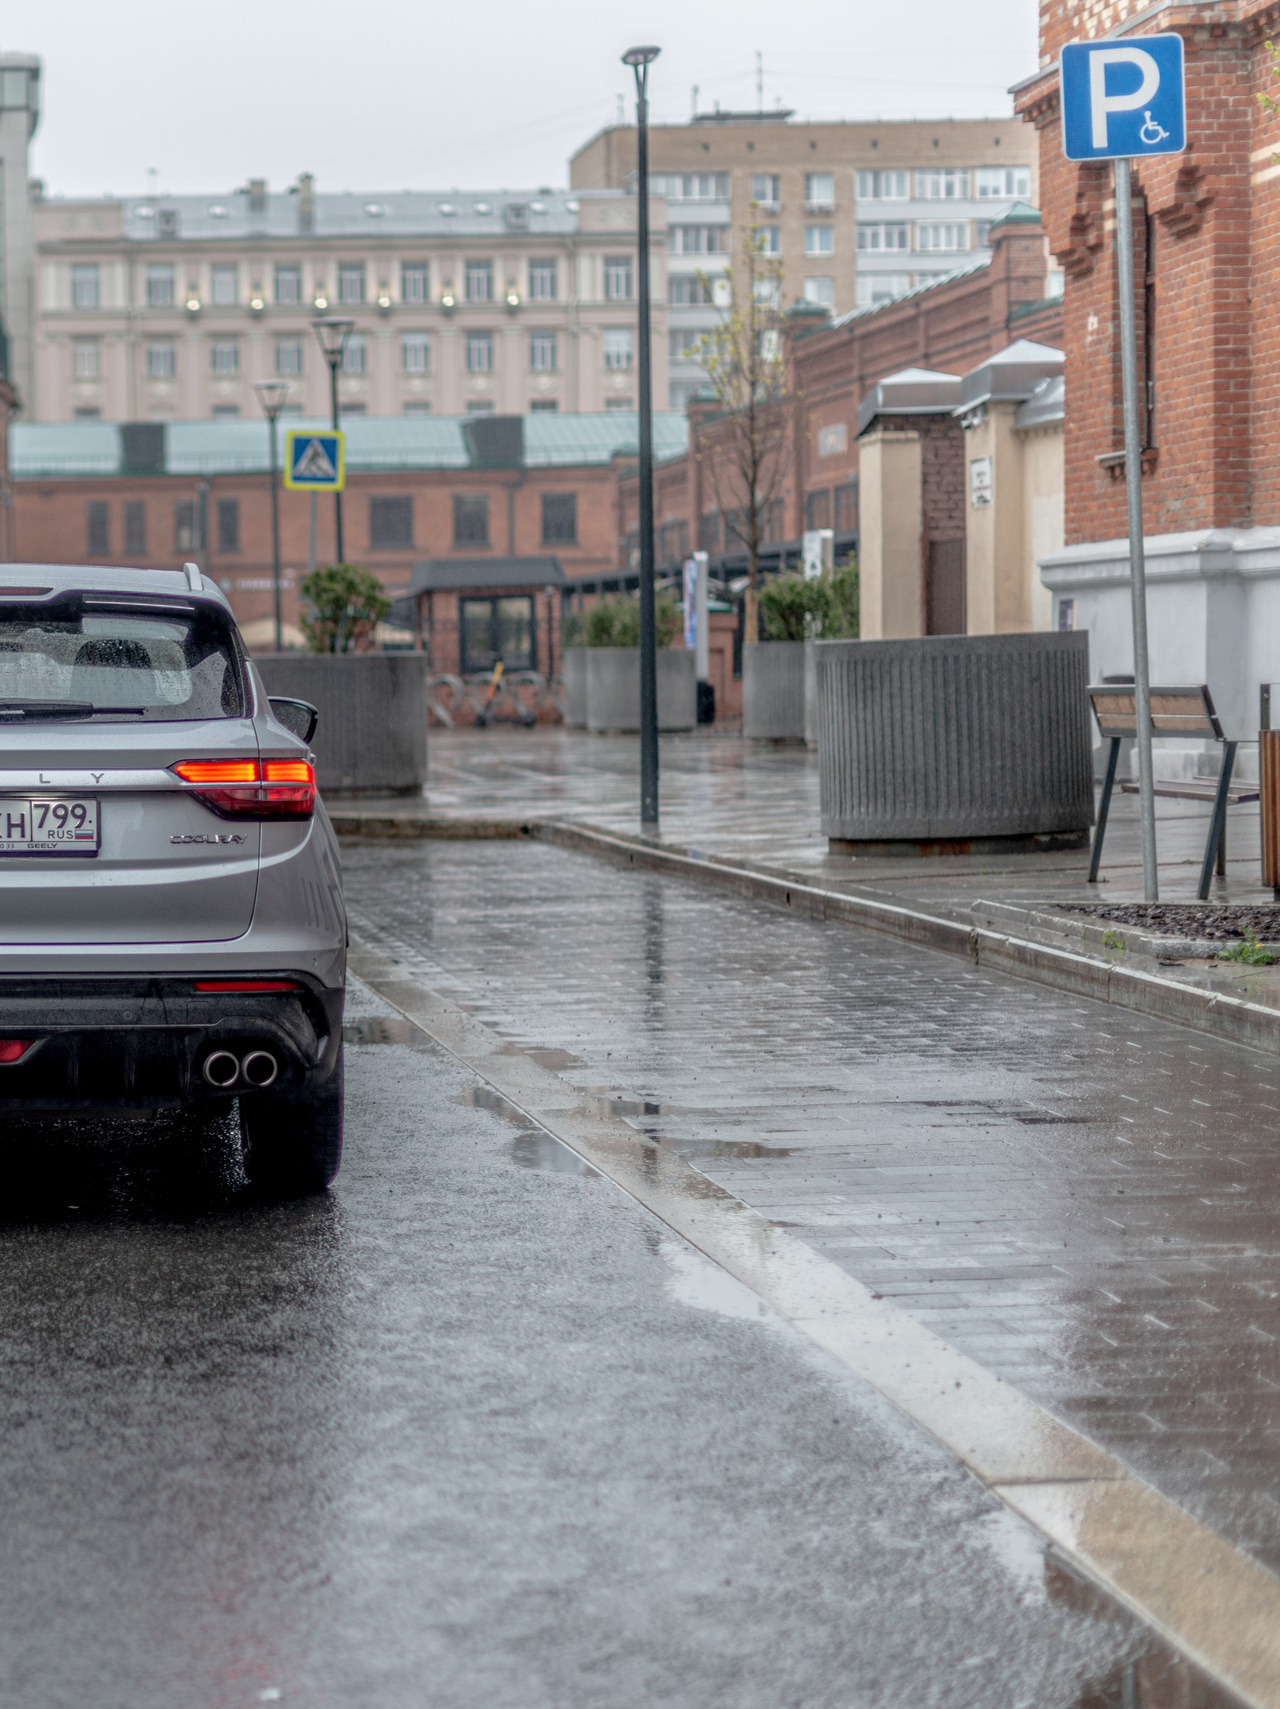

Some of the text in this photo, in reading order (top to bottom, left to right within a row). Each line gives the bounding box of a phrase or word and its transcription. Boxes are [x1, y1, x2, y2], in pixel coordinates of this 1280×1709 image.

[1089, 47, 1161, 149] P
[33, 803, 87, 829] 799
[47, 829, 74, 840] RUS
[169, 834, 248, 844] COOLRAY
